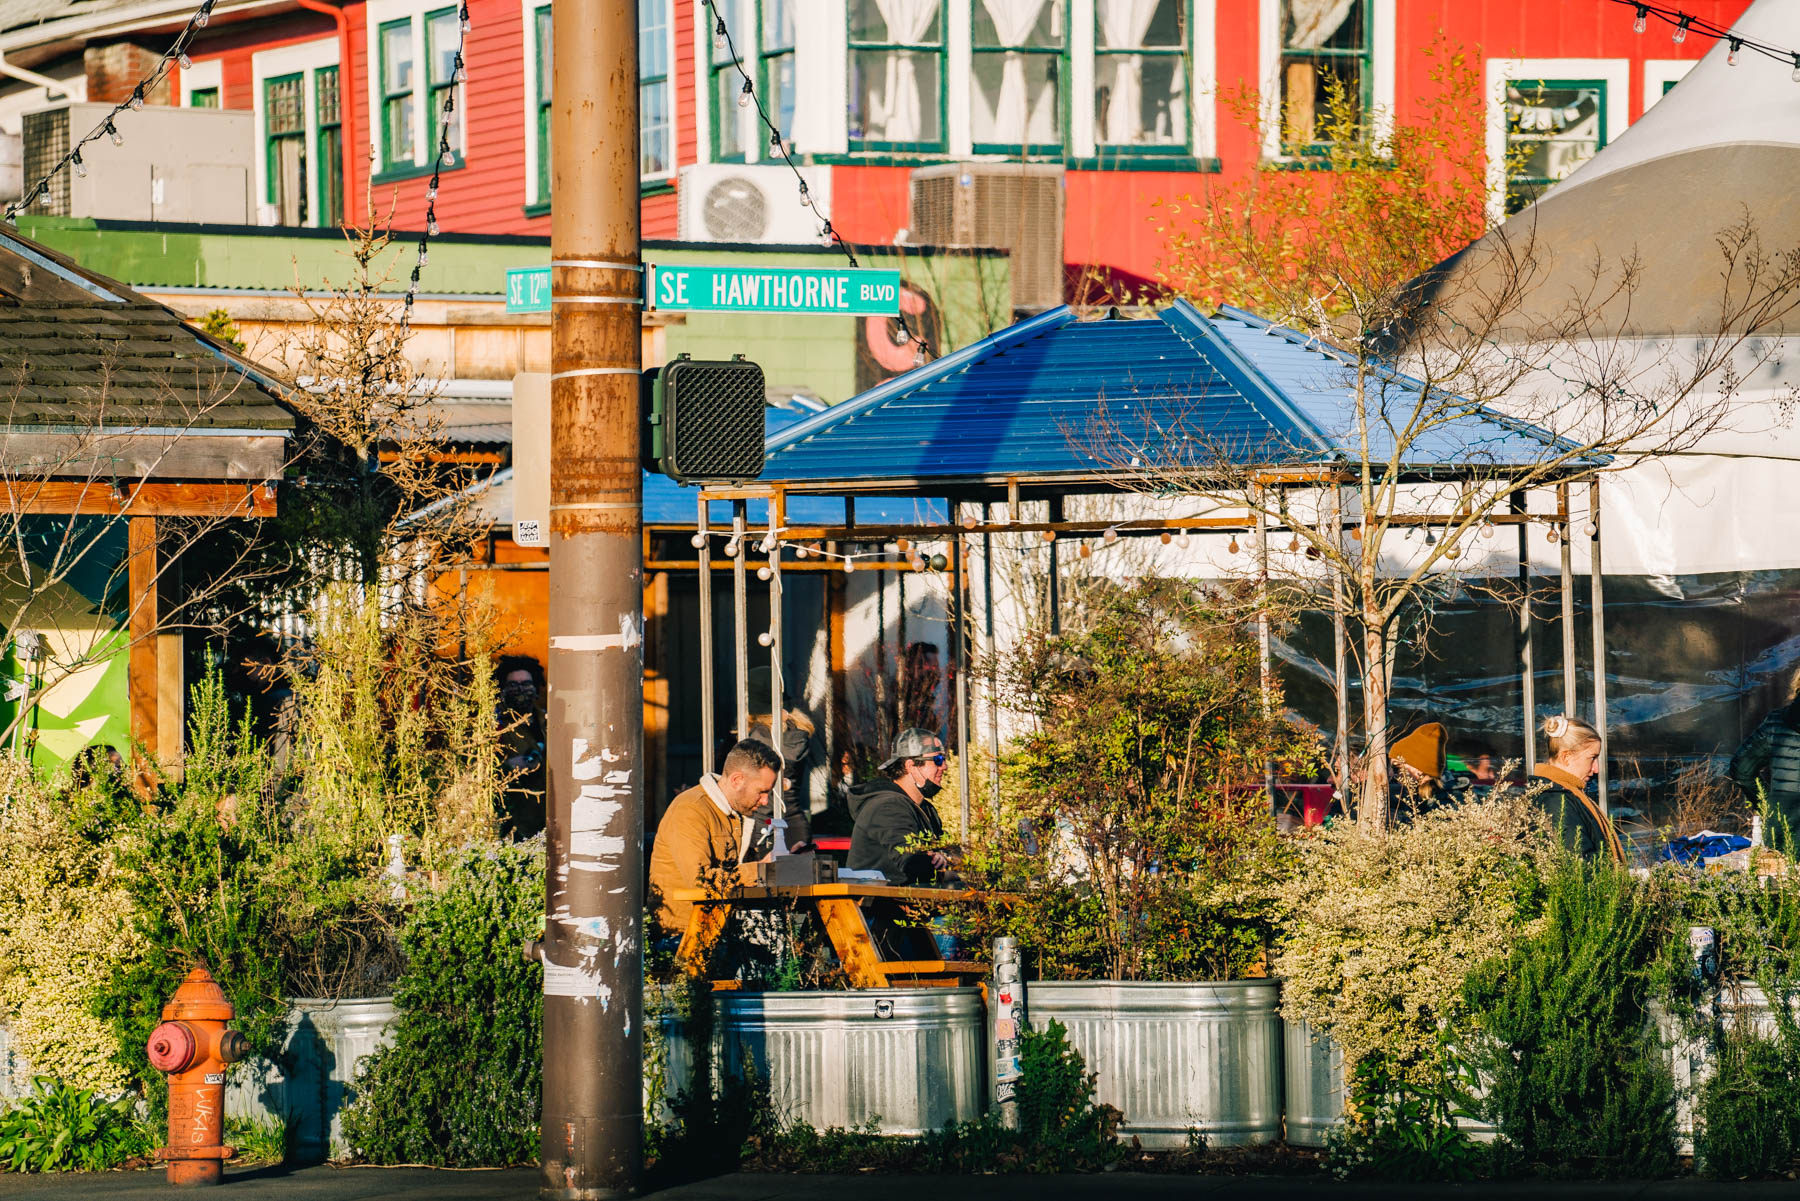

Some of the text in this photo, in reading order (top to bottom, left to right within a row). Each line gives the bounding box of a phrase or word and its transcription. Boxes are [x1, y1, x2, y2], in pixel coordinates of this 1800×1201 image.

[511, 273, 523, 305] SE
[661, 271, 895, 308] SE HAWTHORNE BLVD
